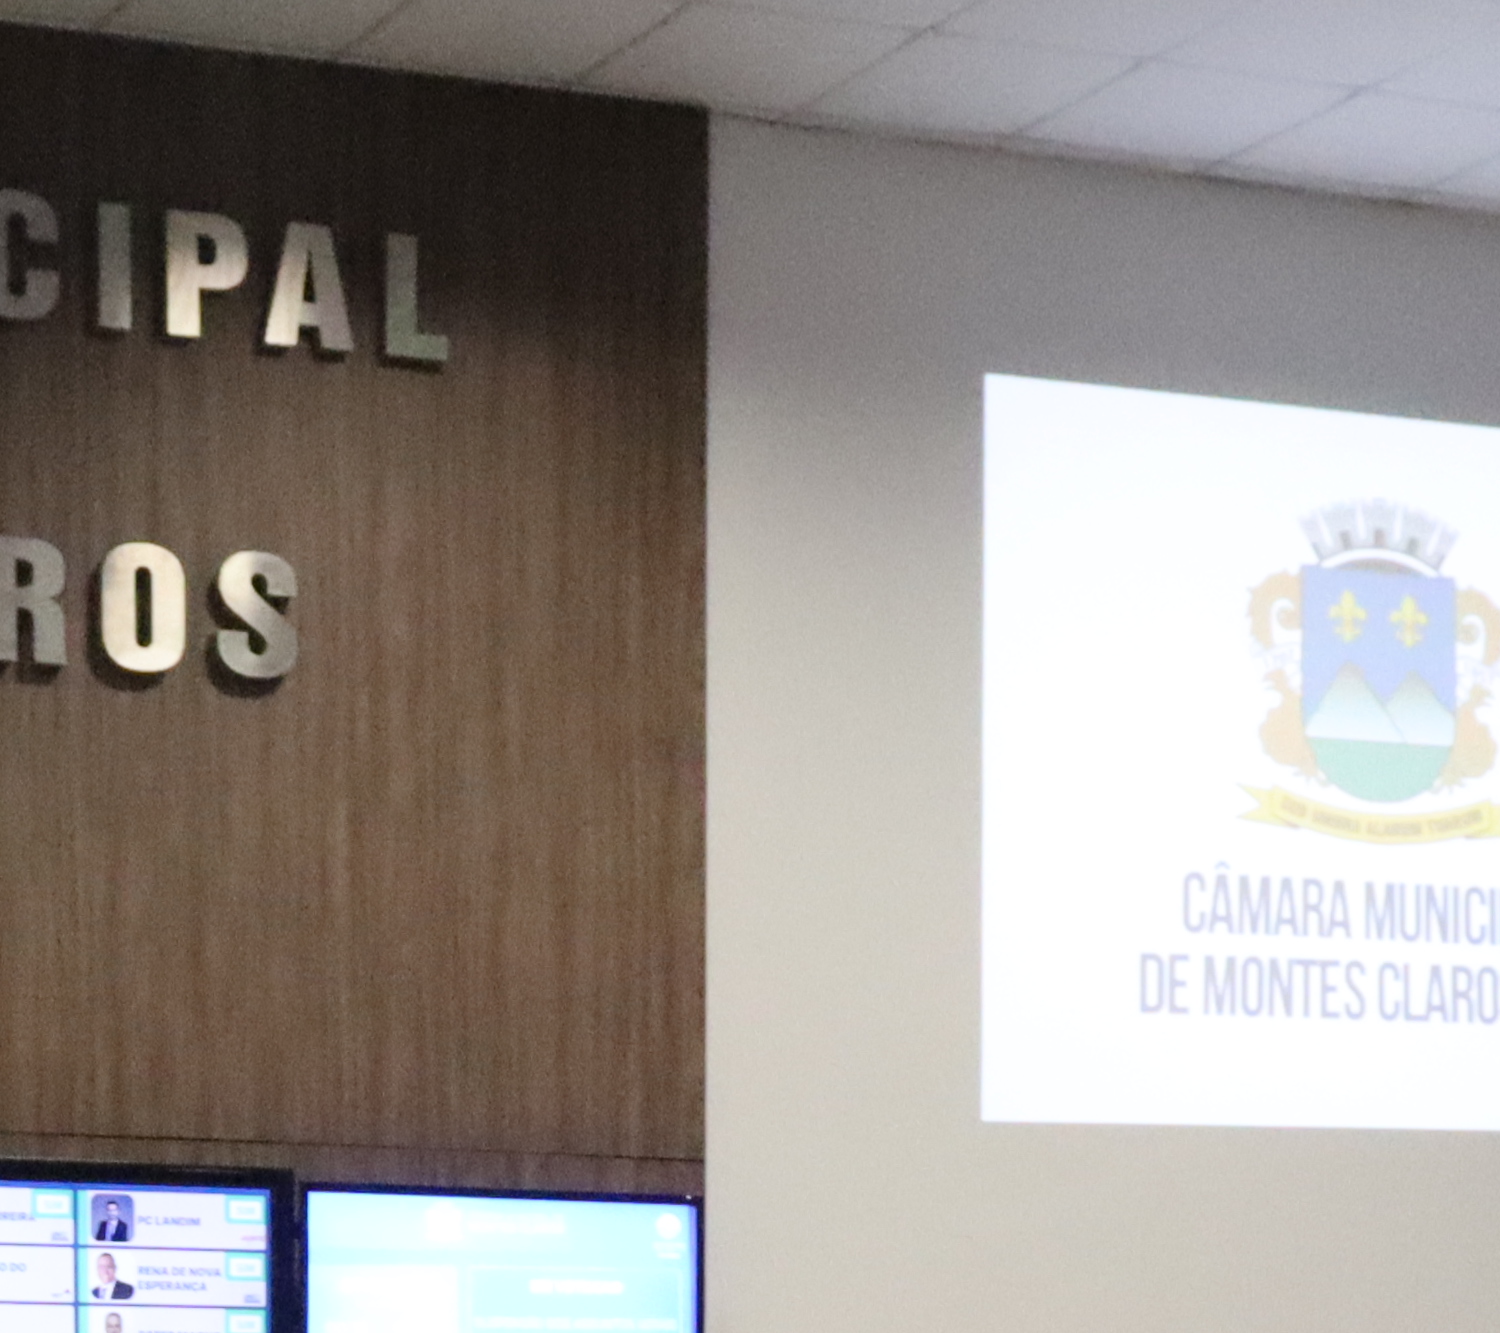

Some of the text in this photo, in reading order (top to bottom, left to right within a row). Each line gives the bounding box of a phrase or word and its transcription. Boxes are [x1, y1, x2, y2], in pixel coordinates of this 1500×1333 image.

[1182, 861, 1352, 941] CÂMARA
[1139, 953, 1190, 1015] DE
[1203, 955, 1367, 1021] MONTES
[10, 1262, 27, 1273] DO
[138, 1265, 169, 1277] RENA
[171, 1266, 187, 1277] DE
